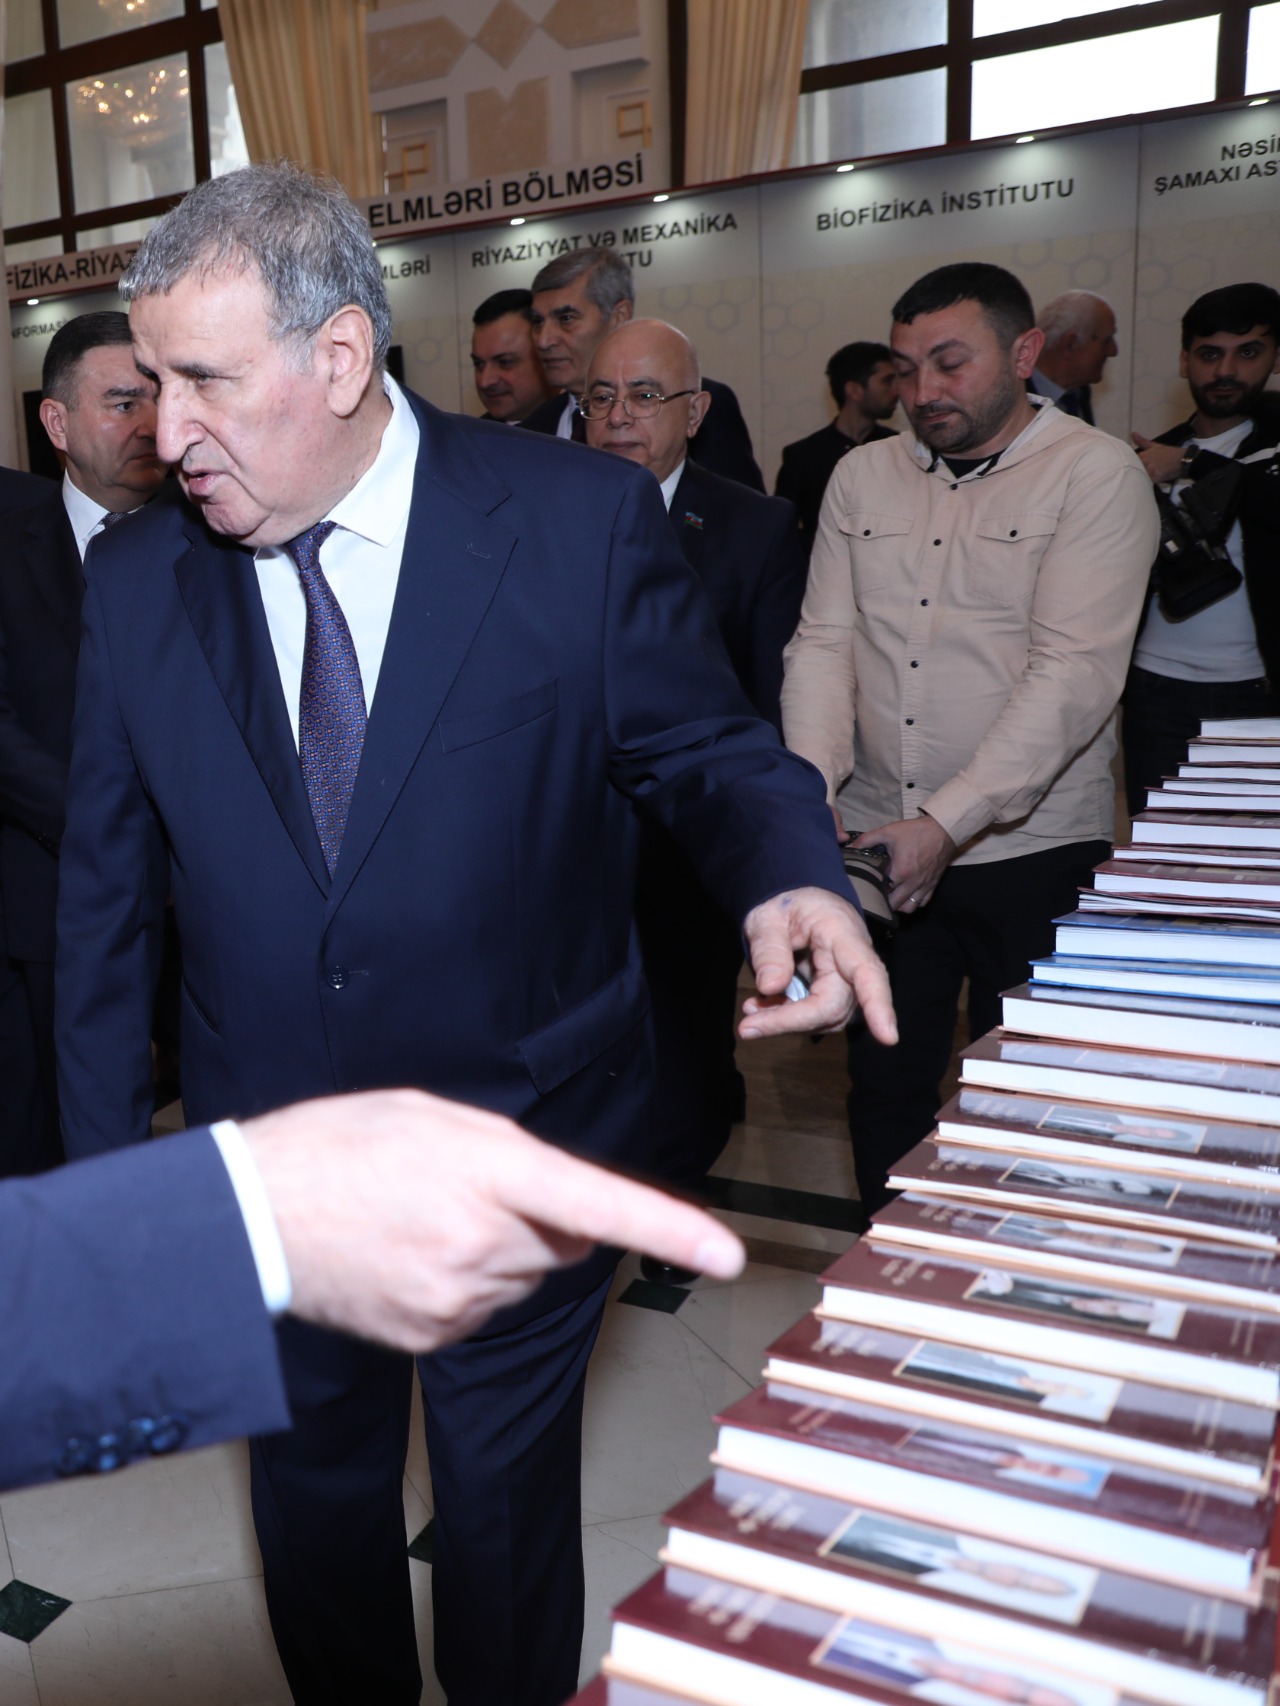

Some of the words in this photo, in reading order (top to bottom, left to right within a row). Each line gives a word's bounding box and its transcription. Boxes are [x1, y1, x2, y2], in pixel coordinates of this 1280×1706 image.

[1221, 134, 1280, 161] NƏSİ
[370, 179, 491, 229] ELMLƏRİ
[503, 153, 644, 207] BÖLMƏSİ
[1154, 165, 1240, 196] ŞAMAXI
[1246, 159, 1280, 180] AS
[816, 198, 934, 231] BİOFİZİKA
[941, 178, 1074, 214] İNSTİTUTU
[472, 234, 582, 268] RİYAZİYYAT
[587, 230, 616, 249] VƏ
[623, 213, 738, 244] MEXANİKA
